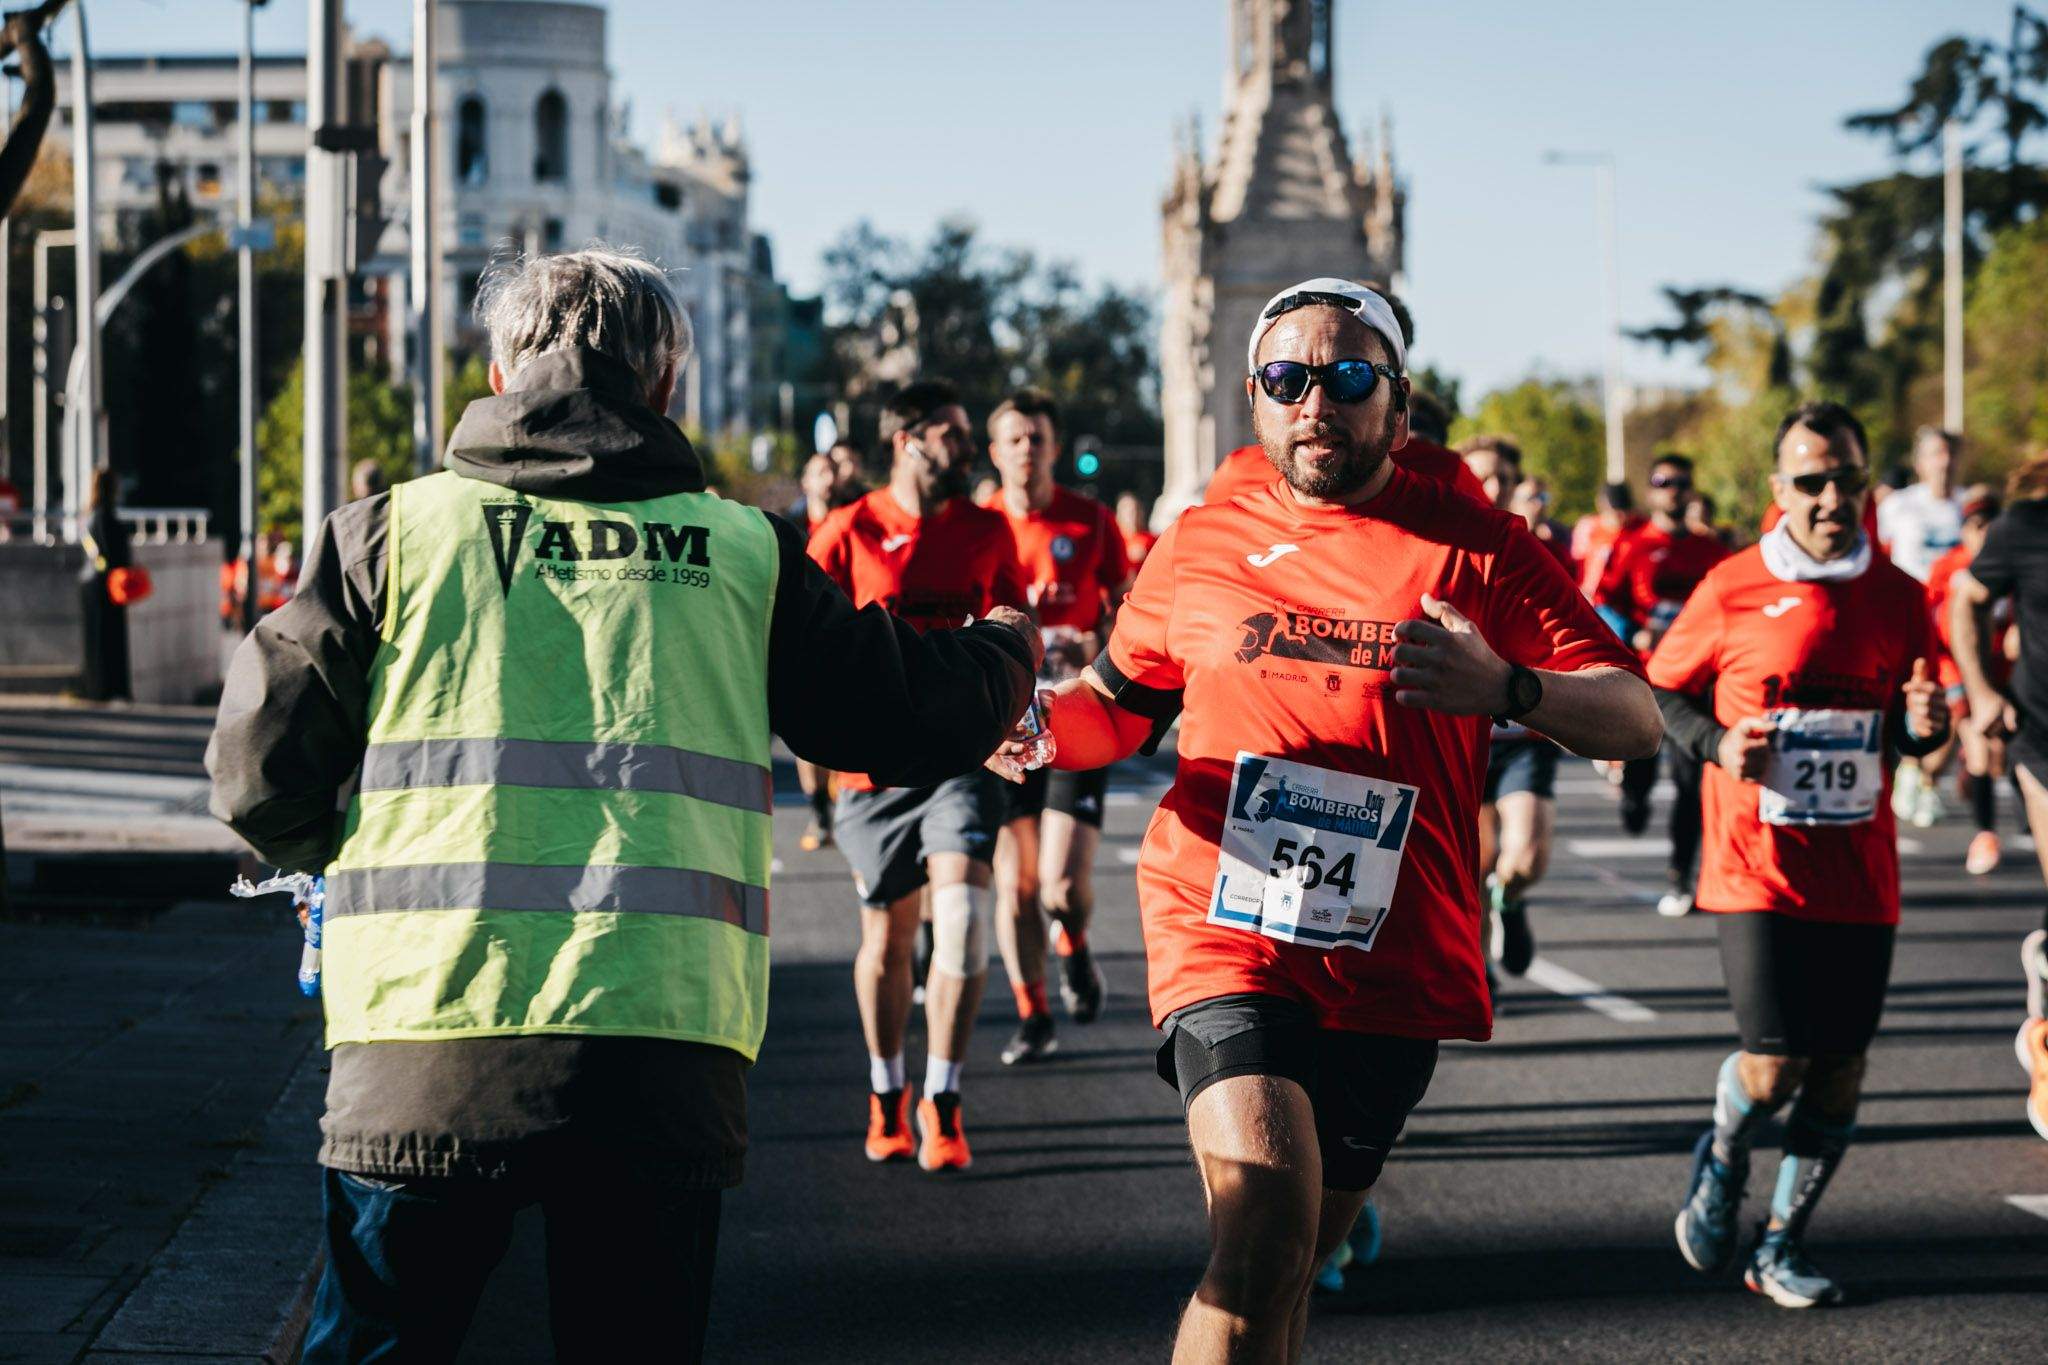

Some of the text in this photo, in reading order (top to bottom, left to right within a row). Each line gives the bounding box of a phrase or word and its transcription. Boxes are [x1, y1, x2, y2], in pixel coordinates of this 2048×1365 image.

[534, 520, 710, 568] ADM
[535, 564, 711, 589] Atletismo desde 1959
[1296, 604, 1346, 617] CARRERA
[1350, 643, 1372, 666] de
[1271, 672, 1308, 684] MADRID
[1794, 759, 1858, 791] 219
[1289, 793, 1379, 823] BOMBEROS
[1269, 838, 1356, 897] 564
